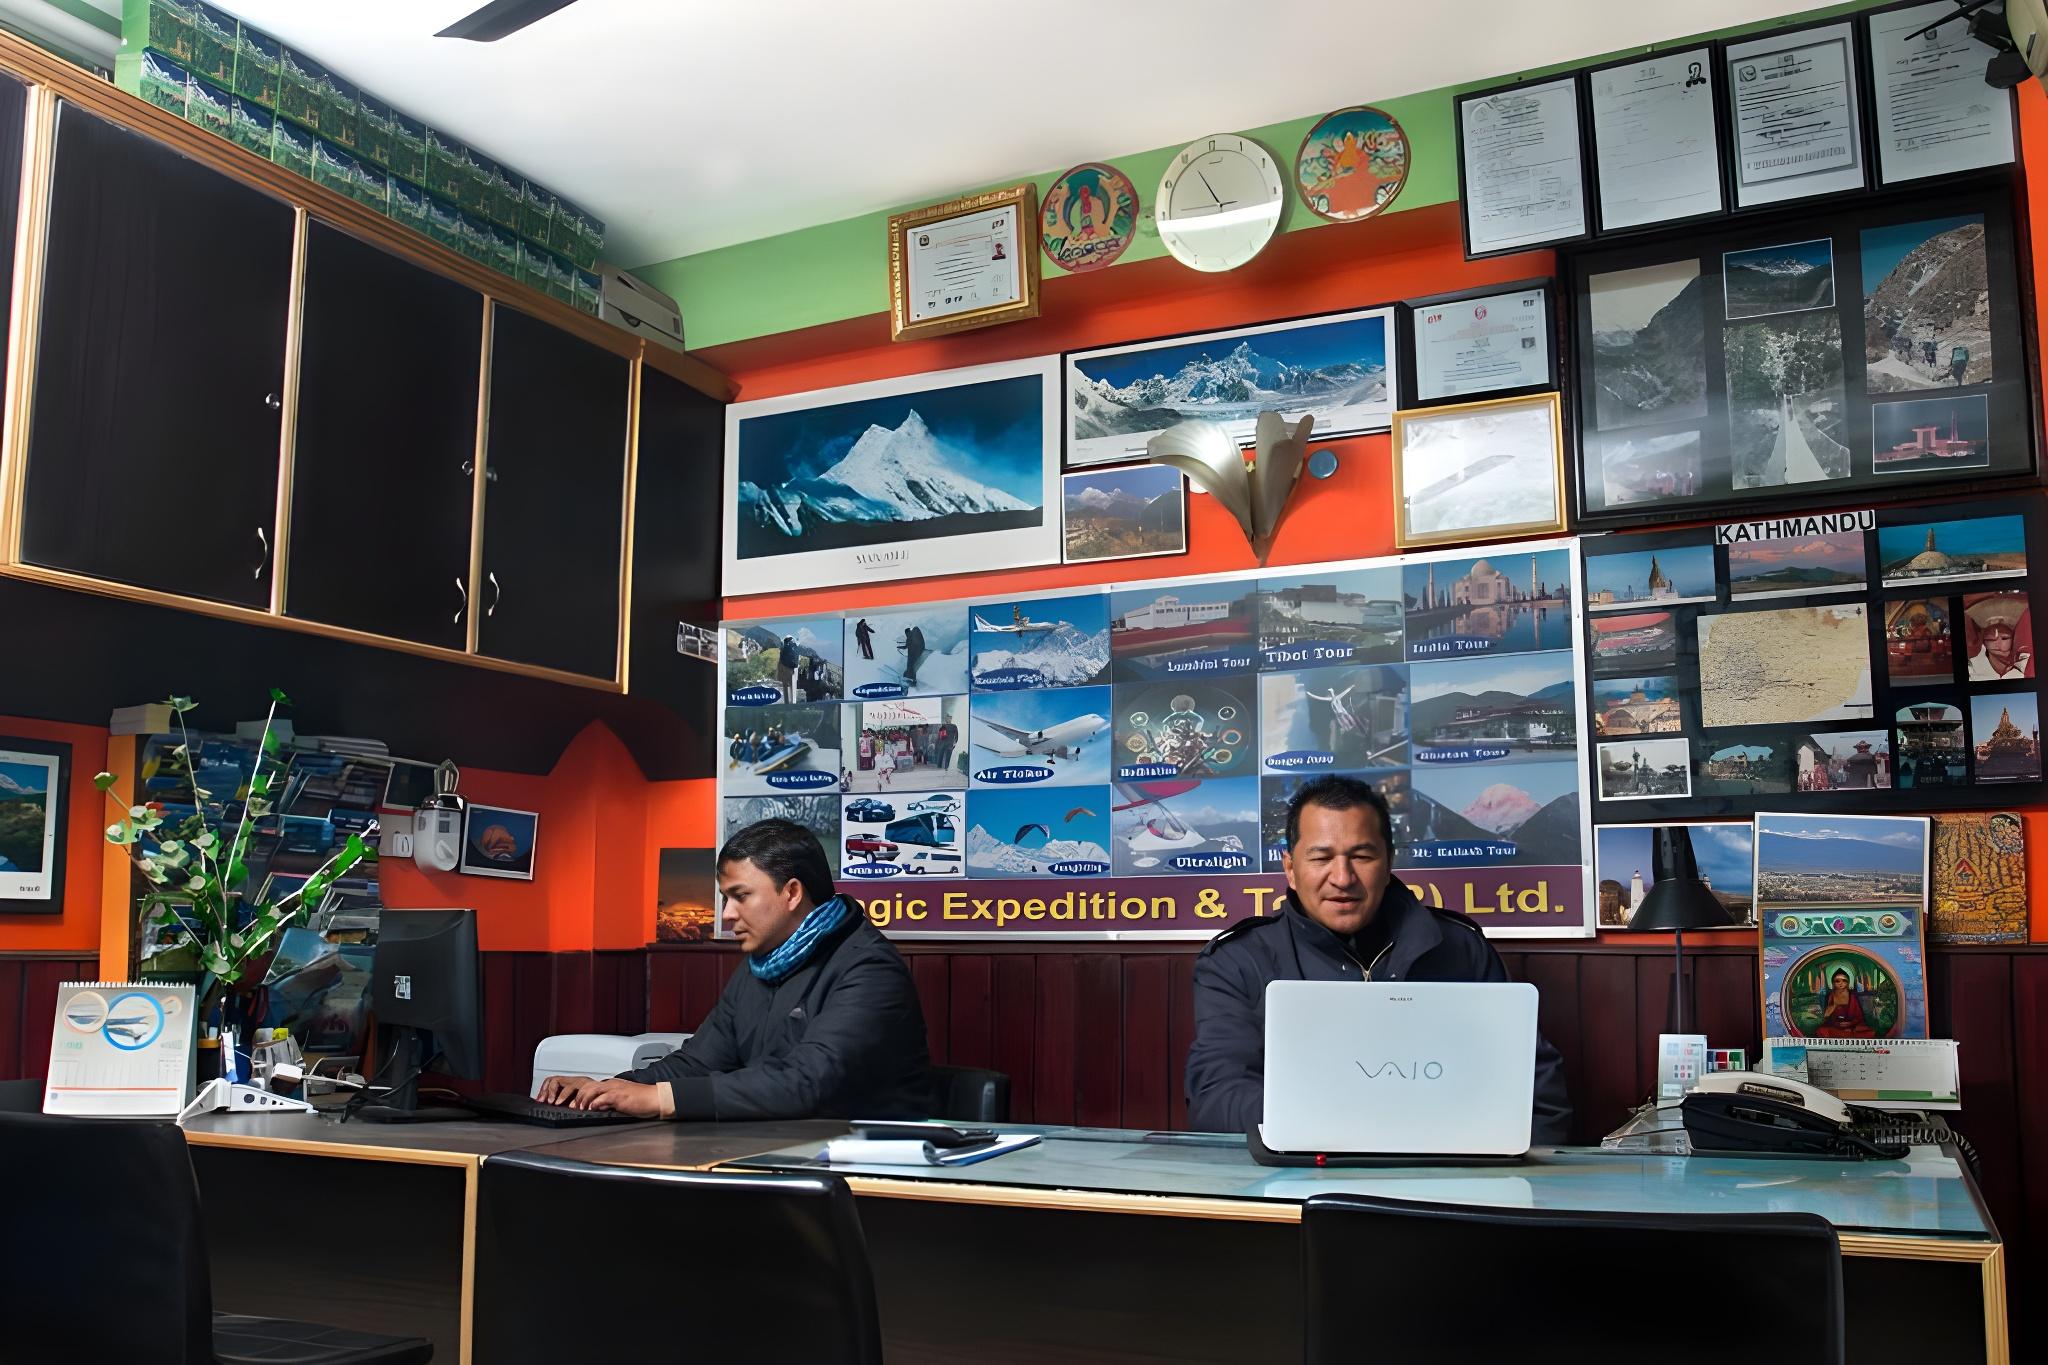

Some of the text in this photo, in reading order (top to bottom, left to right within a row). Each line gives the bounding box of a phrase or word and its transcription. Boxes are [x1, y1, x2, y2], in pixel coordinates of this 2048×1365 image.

[1717, 510, 1875, 544] KATHMANDU
[1176, 856, 1247, 869] Ultralight
[942, 891, 1177, 928] Expedition
[1194, 888, 1228, 919] &
[1464, 881, 1566, 914] Ltd.
[1355, 1060, 1443, 1081] VAIO
